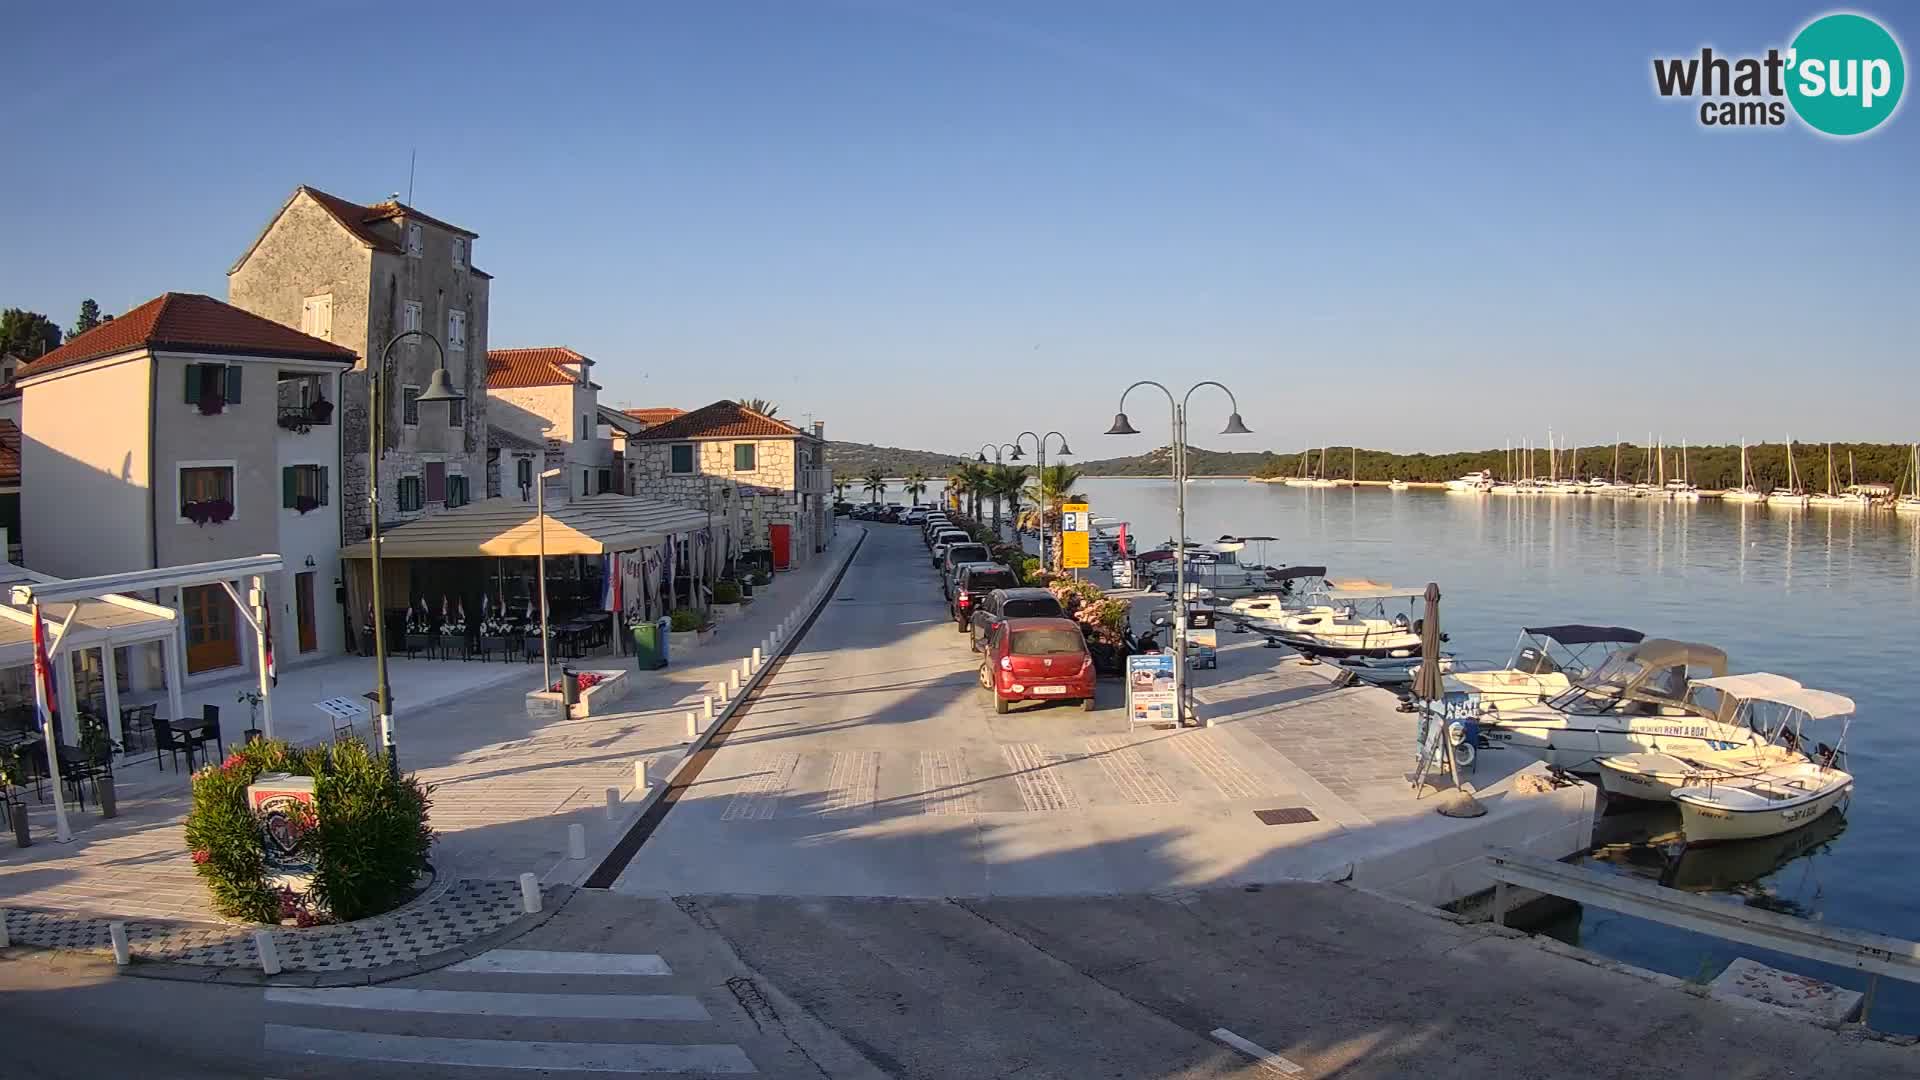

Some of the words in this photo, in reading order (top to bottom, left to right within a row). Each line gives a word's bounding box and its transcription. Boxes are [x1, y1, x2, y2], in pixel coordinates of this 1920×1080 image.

[1064, 513, 1075, 530] P
[1664, 726, 1683, 736] RENT
[1691, 726, 1708, 737] BOAT
